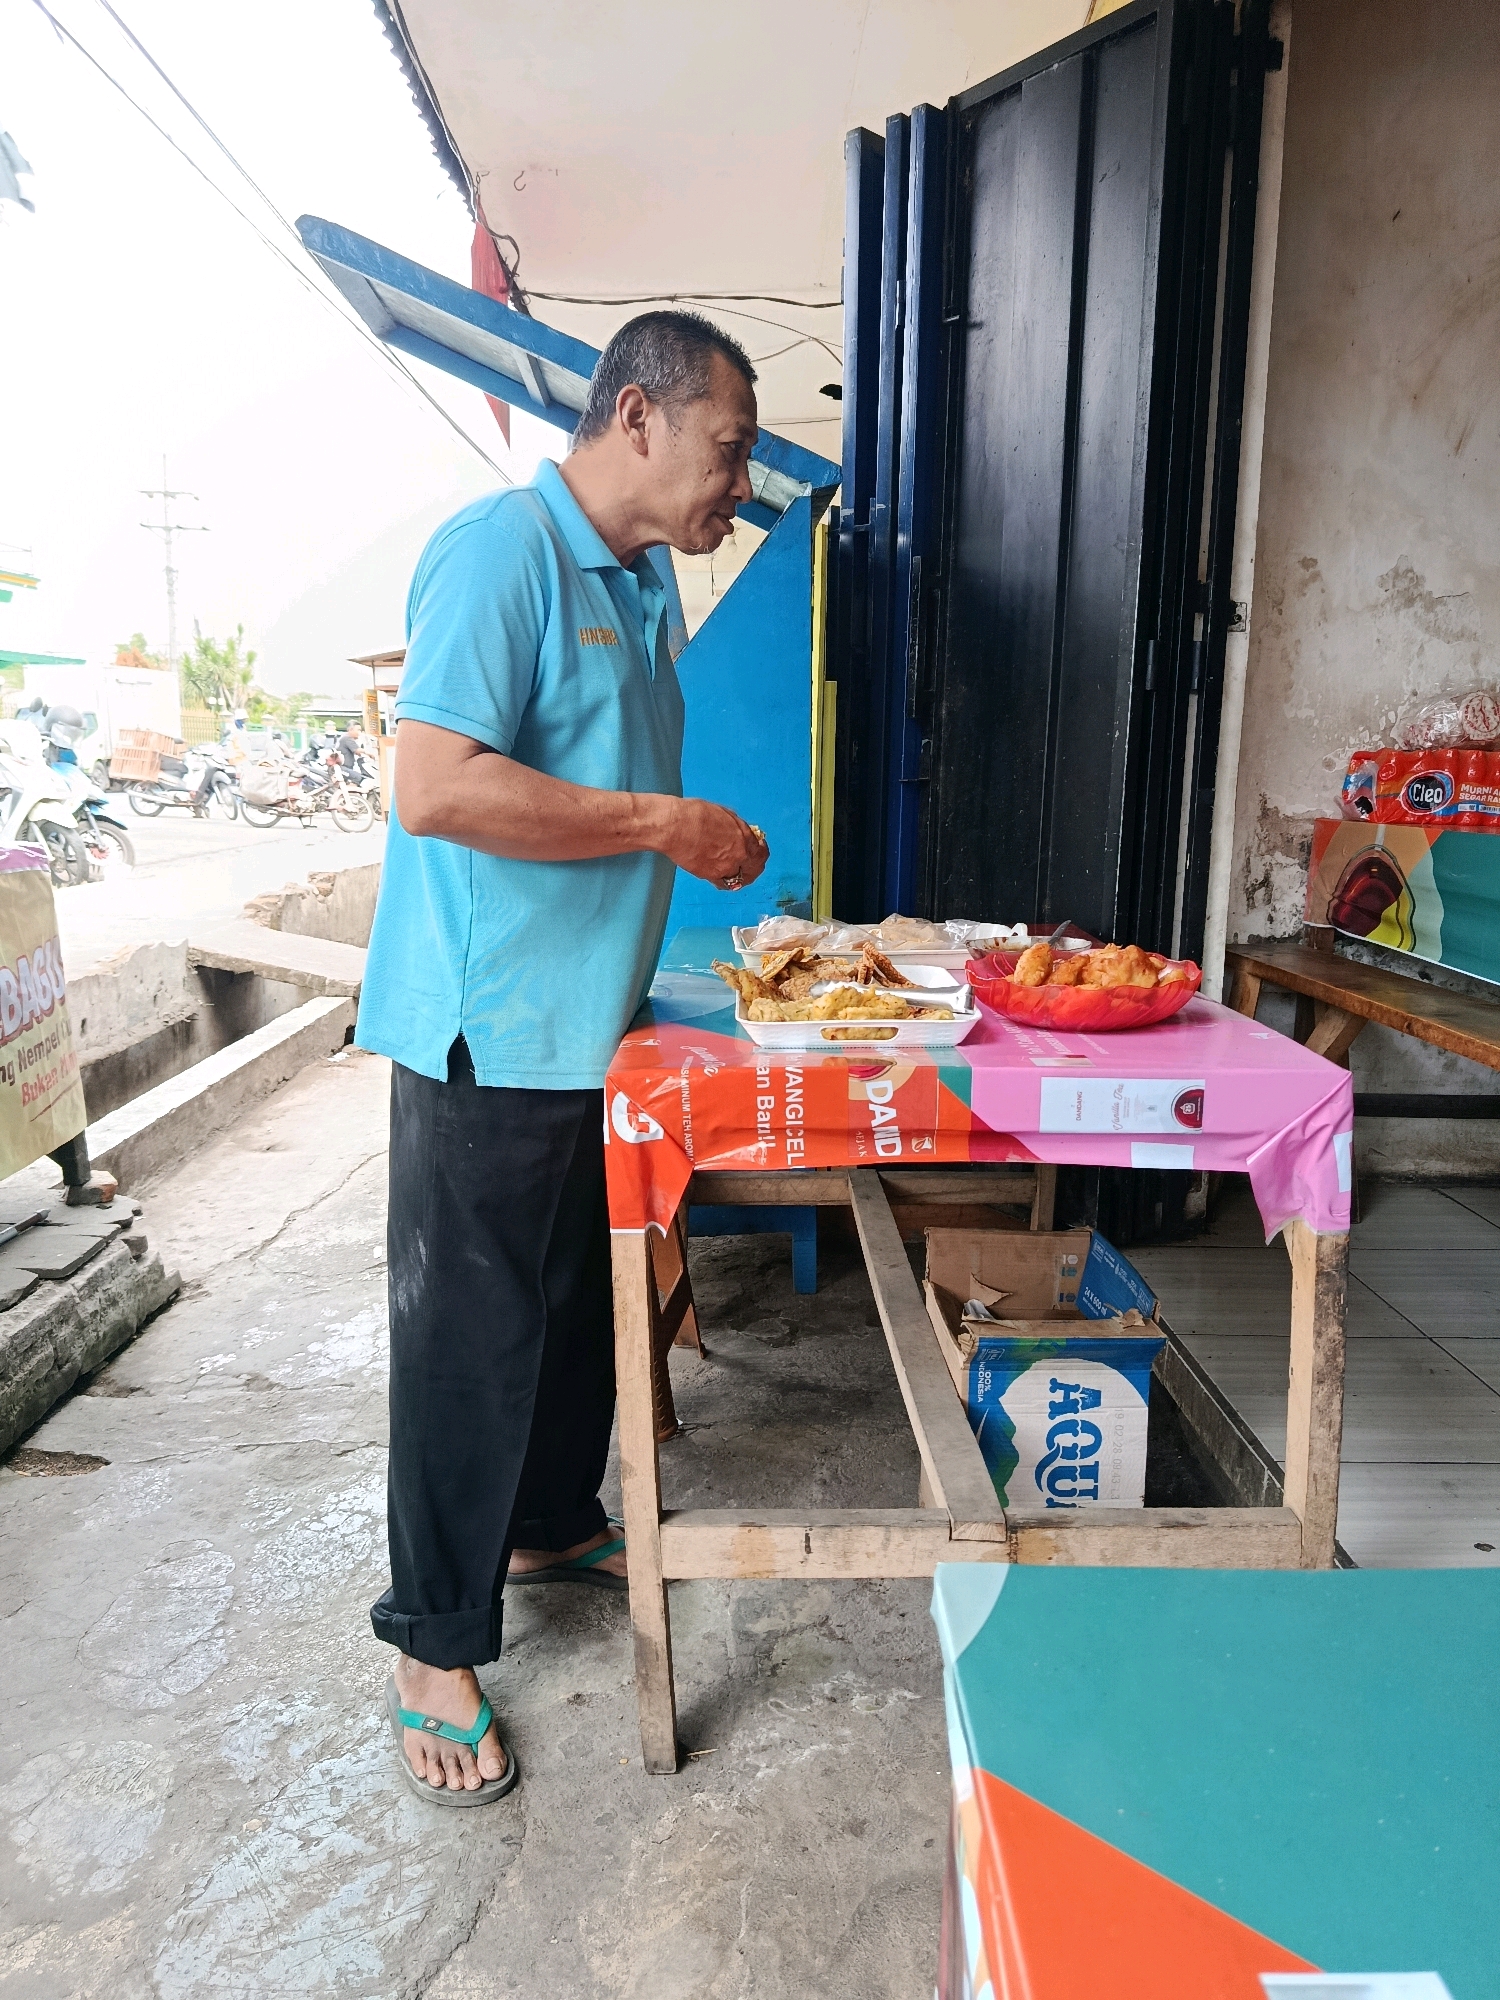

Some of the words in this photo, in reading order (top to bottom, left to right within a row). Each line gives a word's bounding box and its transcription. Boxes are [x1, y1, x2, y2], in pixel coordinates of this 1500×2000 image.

[1413, 783, 1443, 804] Cleo
[1459, 792, 1487, 802] SEGAR
[1460, 783, 1493, 795] MURNI
[0, 935, 66, 1040] BAGU
[18, 1023, 60, 1073] Nempel
[22, 1067, 58, 1107] Bukan
[682, 1114, 692, 1131] TEH
[977, 1361, 986, 1403] INDONESIA
[1034, 1377, 1103, 1508] AQU
